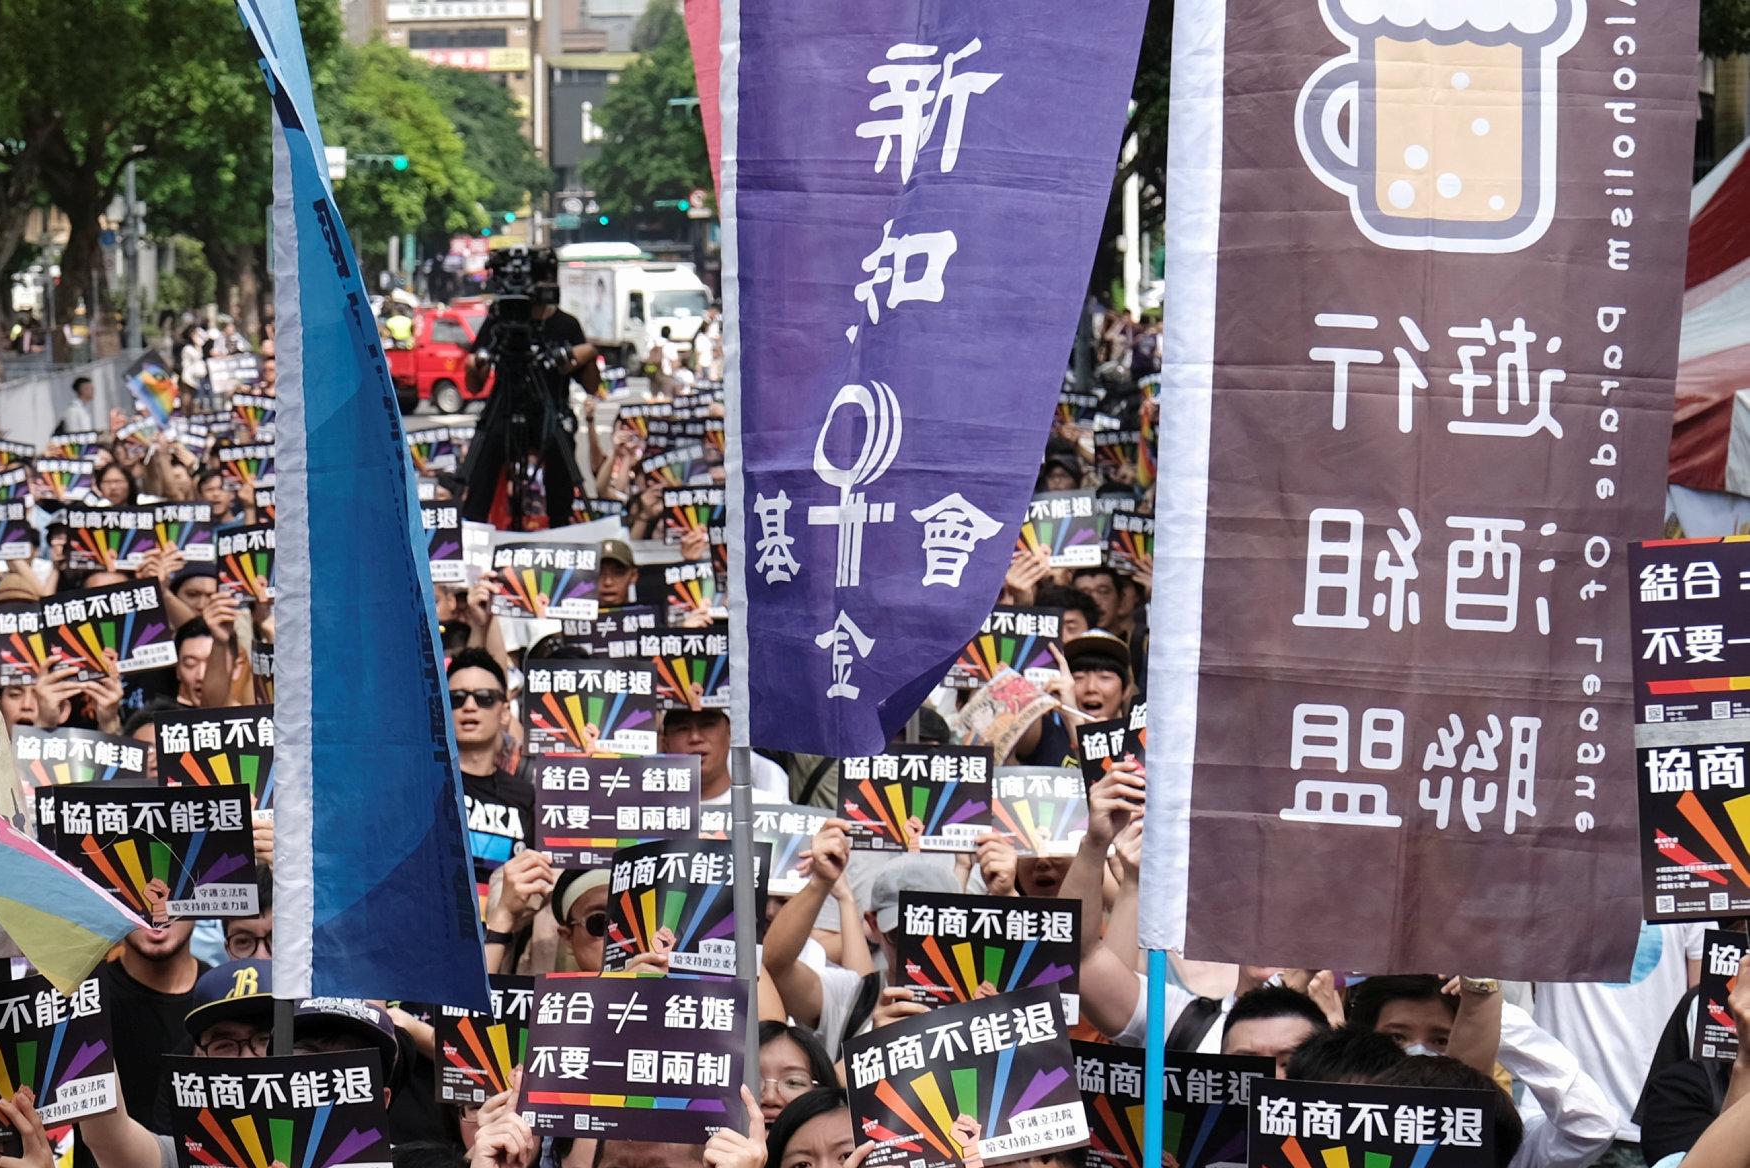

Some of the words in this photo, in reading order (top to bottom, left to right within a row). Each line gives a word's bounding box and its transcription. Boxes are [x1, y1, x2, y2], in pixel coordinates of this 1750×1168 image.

[495, 548, 596, 570] 協商不能退
[1639, 562, 1722, 602] 結合
[43, 586, 159, 627] 協商不能退
[528, 670, 651, 696] 協商不能退
[16, 735, 143, 772] 協商不能退
[843, 755, 987, 783] 協商不能退
[541, 767, 591, 792] 結合
[642, 769, 691, 793] 結婚
[61, 800, 243, 836] 協商不能退
[541, 806, 691, 831] 不要一國兩制
[905, 904, 1073, 943] 協商不能退
[536, 992, 595, 1026] 結合
[664, 995, 735, 1033] 結婚
[851, 1002, 1058, 1089] 協商不能退
[528, 1046, 731, 1087] 不要一國兩制
[172, 1066, 371, 1109] 協商不能退
[1015, 1110, 1074, 1131] 守護立法院
[1258, 1096, 1483, 1147] 協商不能退
